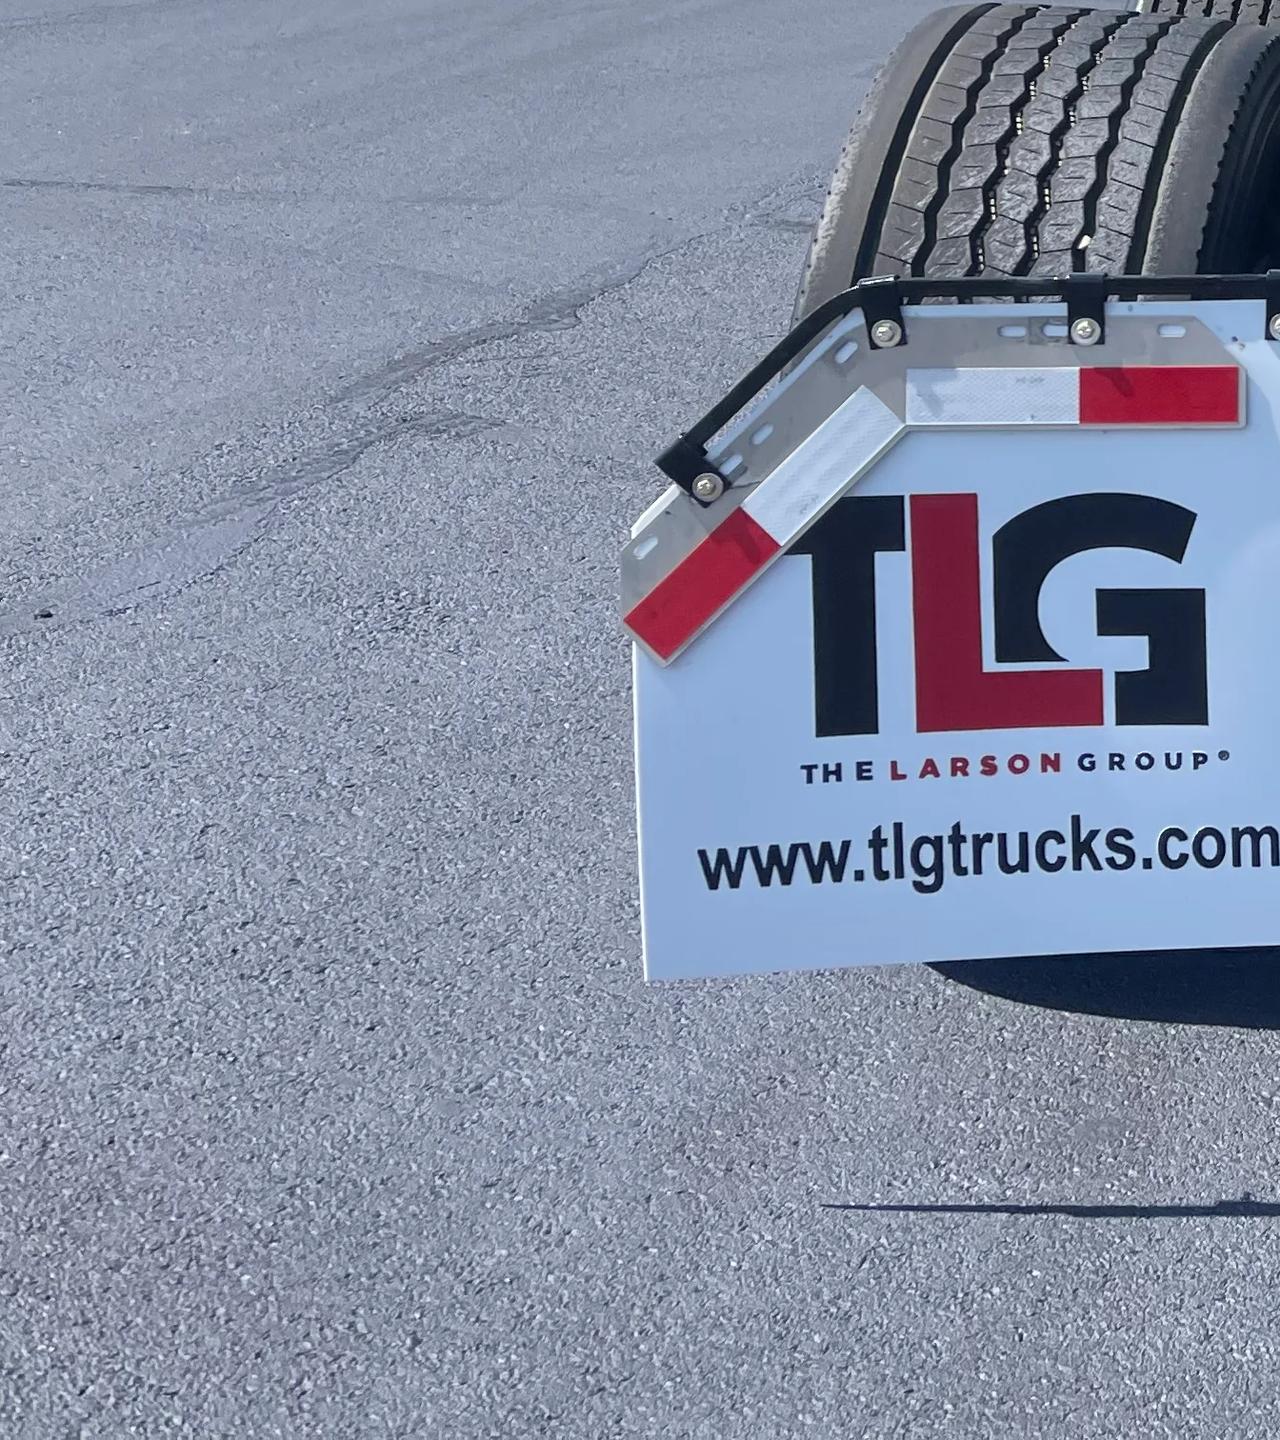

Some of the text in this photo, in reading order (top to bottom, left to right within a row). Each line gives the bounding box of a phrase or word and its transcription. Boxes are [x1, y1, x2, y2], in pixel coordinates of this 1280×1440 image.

[785, 492, 1210, 737] TLG
[801, 761, 873, 784] THE
[889, 752, 1061, 781] LARSON
